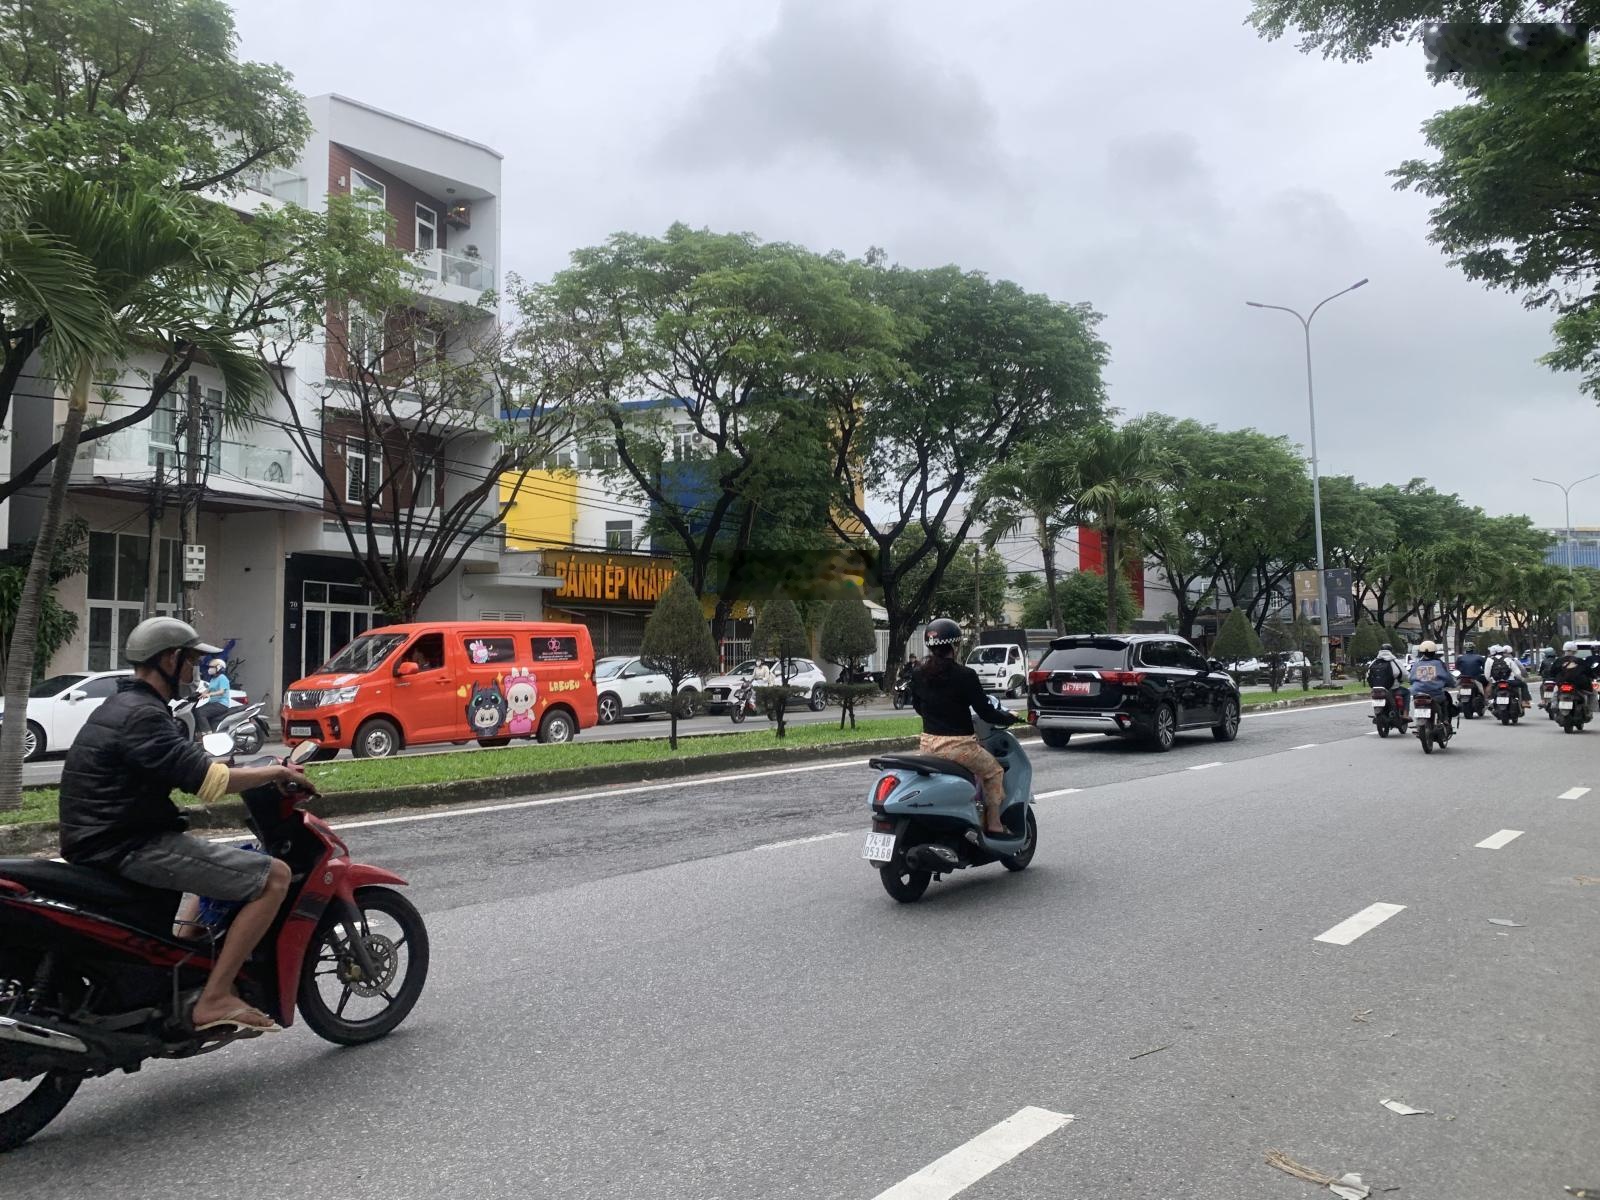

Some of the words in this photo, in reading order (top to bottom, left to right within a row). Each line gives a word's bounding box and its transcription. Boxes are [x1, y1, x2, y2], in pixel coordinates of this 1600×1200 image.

[555, 555, 602, 599] BÁNH
[605, 558, 625, 600] ÉP
[549, 679, 580, 692] LABUBU
